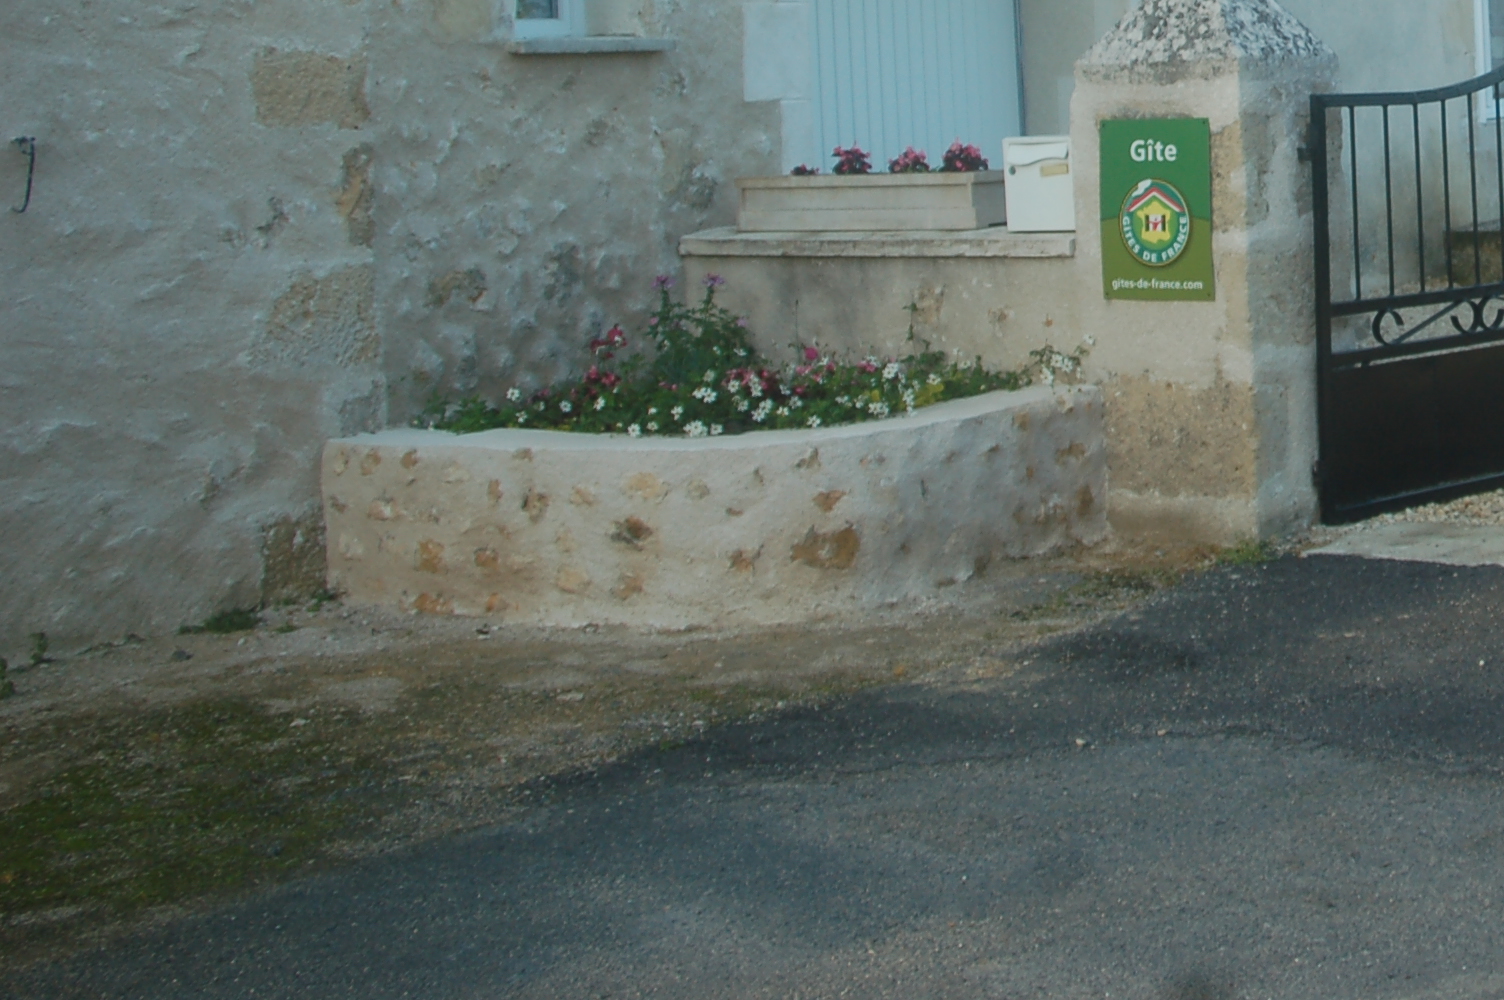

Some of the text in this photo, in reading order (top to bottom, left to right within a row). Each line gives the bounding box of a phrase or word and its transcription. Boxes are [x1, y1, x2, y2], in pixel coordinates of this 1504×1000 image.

[1130, 139, 1177, 162] Gîte
[1142, 250, 1157, 263] DE
[1161, 216, 1187, 262] FRANCE
[1112, 278, 1203, 290] gites-de-france.com
